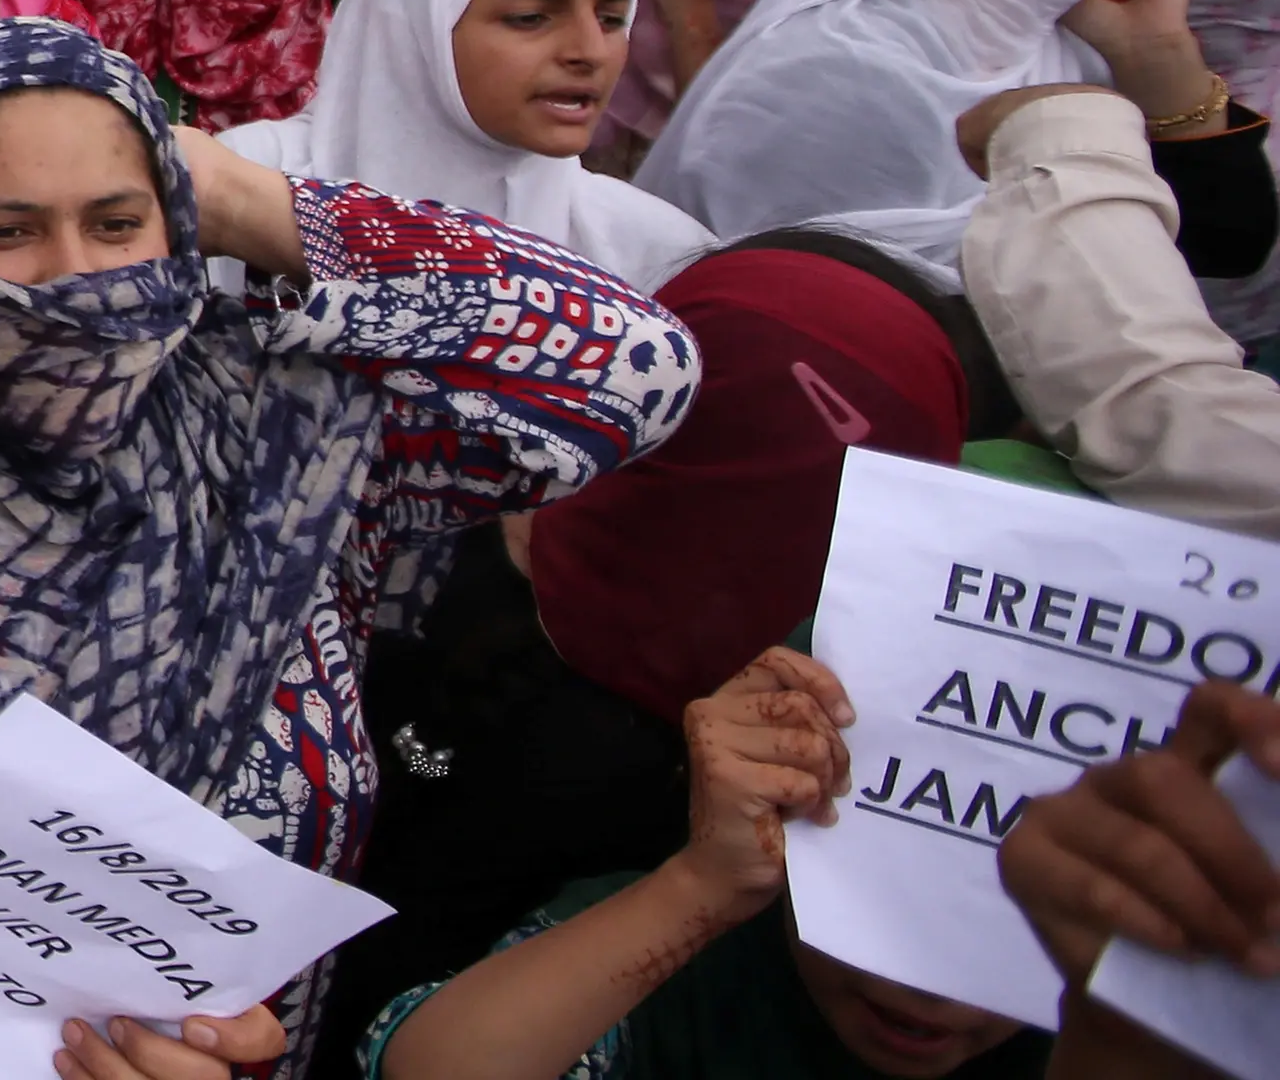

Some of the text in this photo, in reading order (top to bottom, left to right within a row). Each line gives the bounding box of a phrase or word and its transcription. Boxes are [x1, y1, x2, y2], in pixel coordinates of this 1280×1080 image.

[943, 562, 1280, 699] FREEDO
[30, 810, 259, 937] 16/8/2019
[77, 903, 216, 1001] MEDIA
